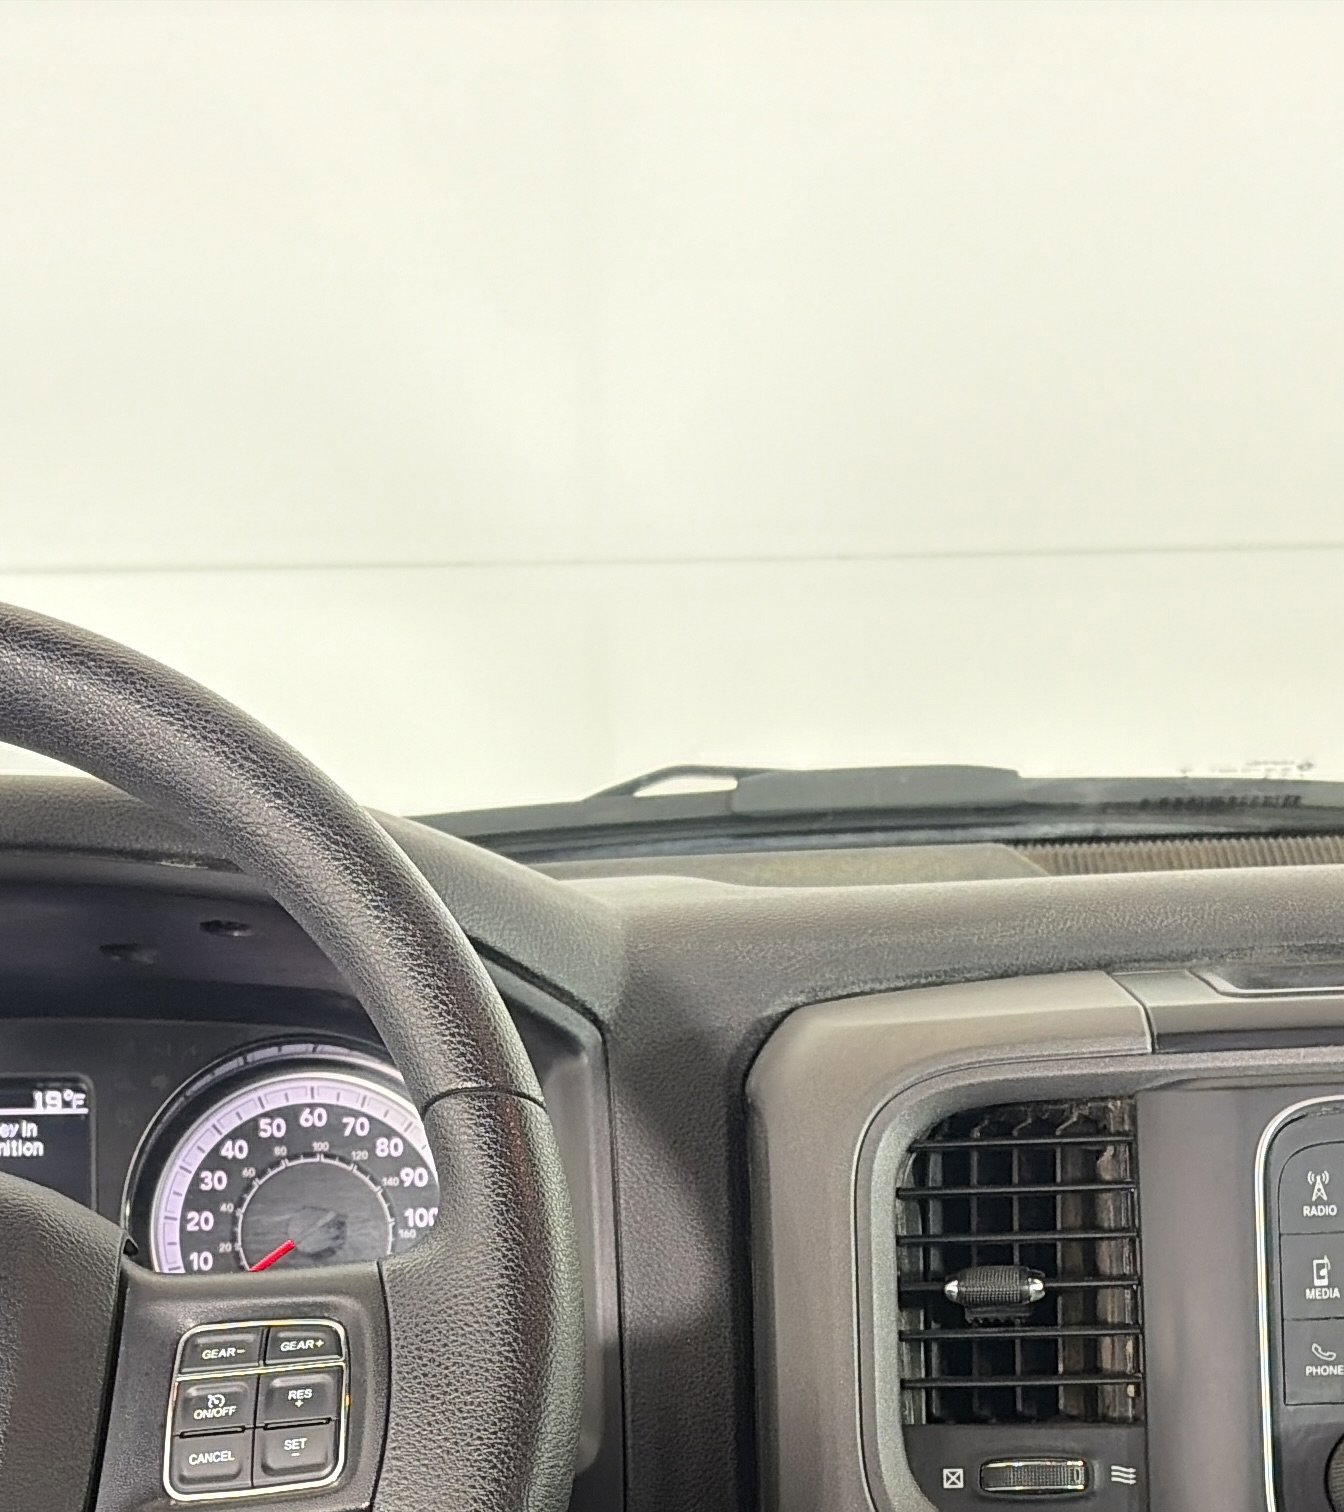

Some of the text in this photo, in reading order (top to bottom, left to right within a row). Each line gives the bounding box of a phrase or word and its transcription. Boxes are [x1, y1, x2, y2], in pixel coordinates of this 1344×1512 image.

[299, 1107, 328, 1128] 60
[258, 1118, 286, 1138] 50
[342, 1116, 370, 1138] 70
[220, 1139, 249, 1160] 40
[274, 1146, 288, 1157] 80
[312, 1141, 330, 1152] 100
[375, 1136, 404, 1158] 80
[350, 1150, 369, 1161] 120
[242, 1166, 256, 1178] 60
[400, 1166, 429, 1188] 90
[199, 1170, 228, 1191] 30
[381, 1176, 400, 1187] 140
[219, 1202, 234, 1213] 40
[1302, 1204, 1338, 1217] RADIO
[186, 1211, 214, 1232] 20
[218, 1242, 232, 1253] 20
[188, 1251, 214, 1272] 10
[1305, 1287, 1341, 1300] MEDIA
[1305, 1364, 1344, 1377] PHONE
[288, 1388, 313, 1400] RES
[193, 1406, 236, 1420] ON/OFF
[284, 1438, 308, 1450] SET
[188, 1450, 236, 1466] CANCEL
